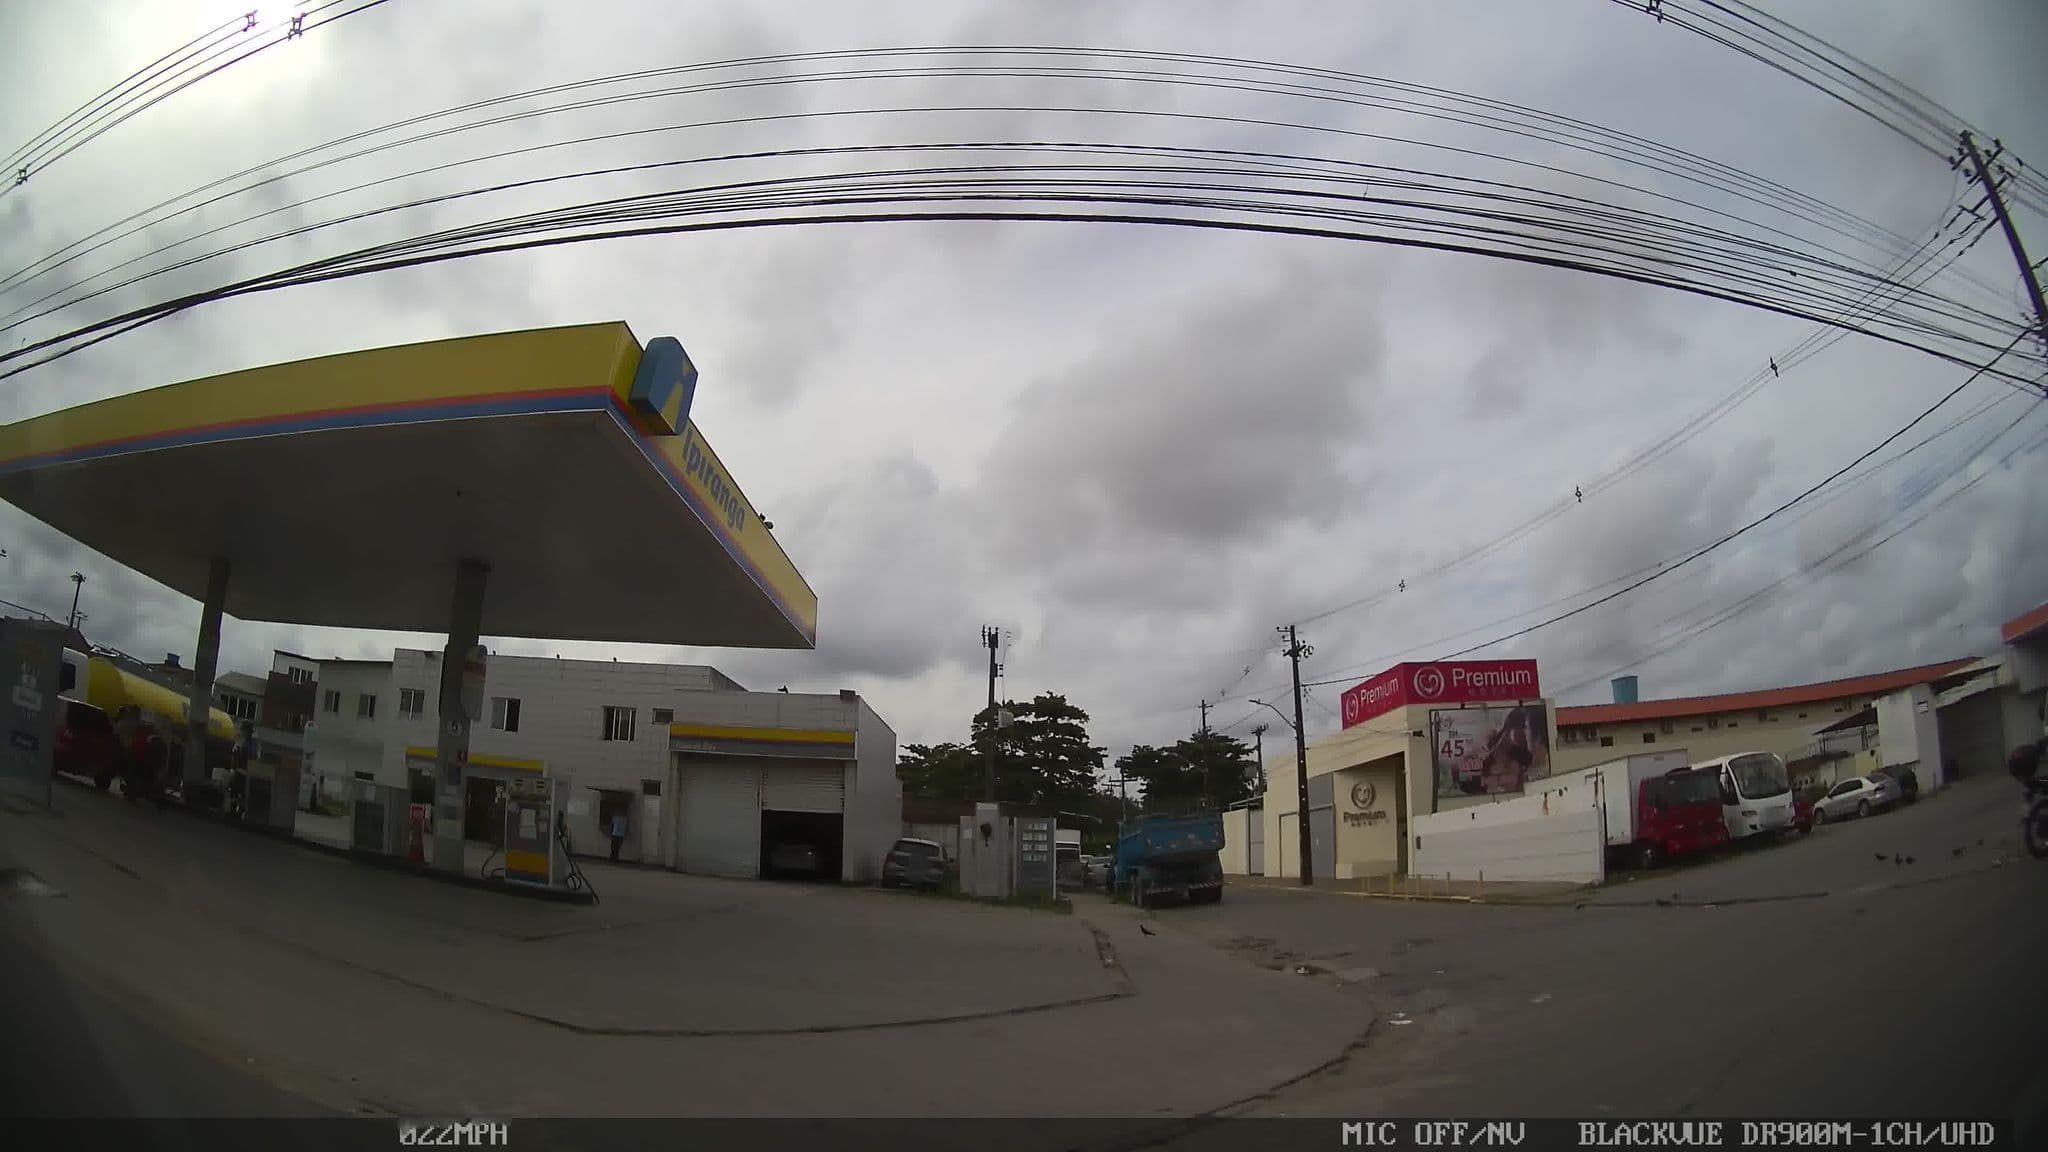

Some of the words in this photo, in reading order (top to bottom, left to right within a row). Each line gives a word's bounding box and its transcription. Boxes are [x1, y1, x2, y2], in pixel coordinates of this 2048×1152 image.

[682, 428, 746, 532] Ipiranga
[1453, 666, 1531, 688] Premium
[1361, 678, 1399, 704] Premium
[1441, 740, 1465, 758] 45
